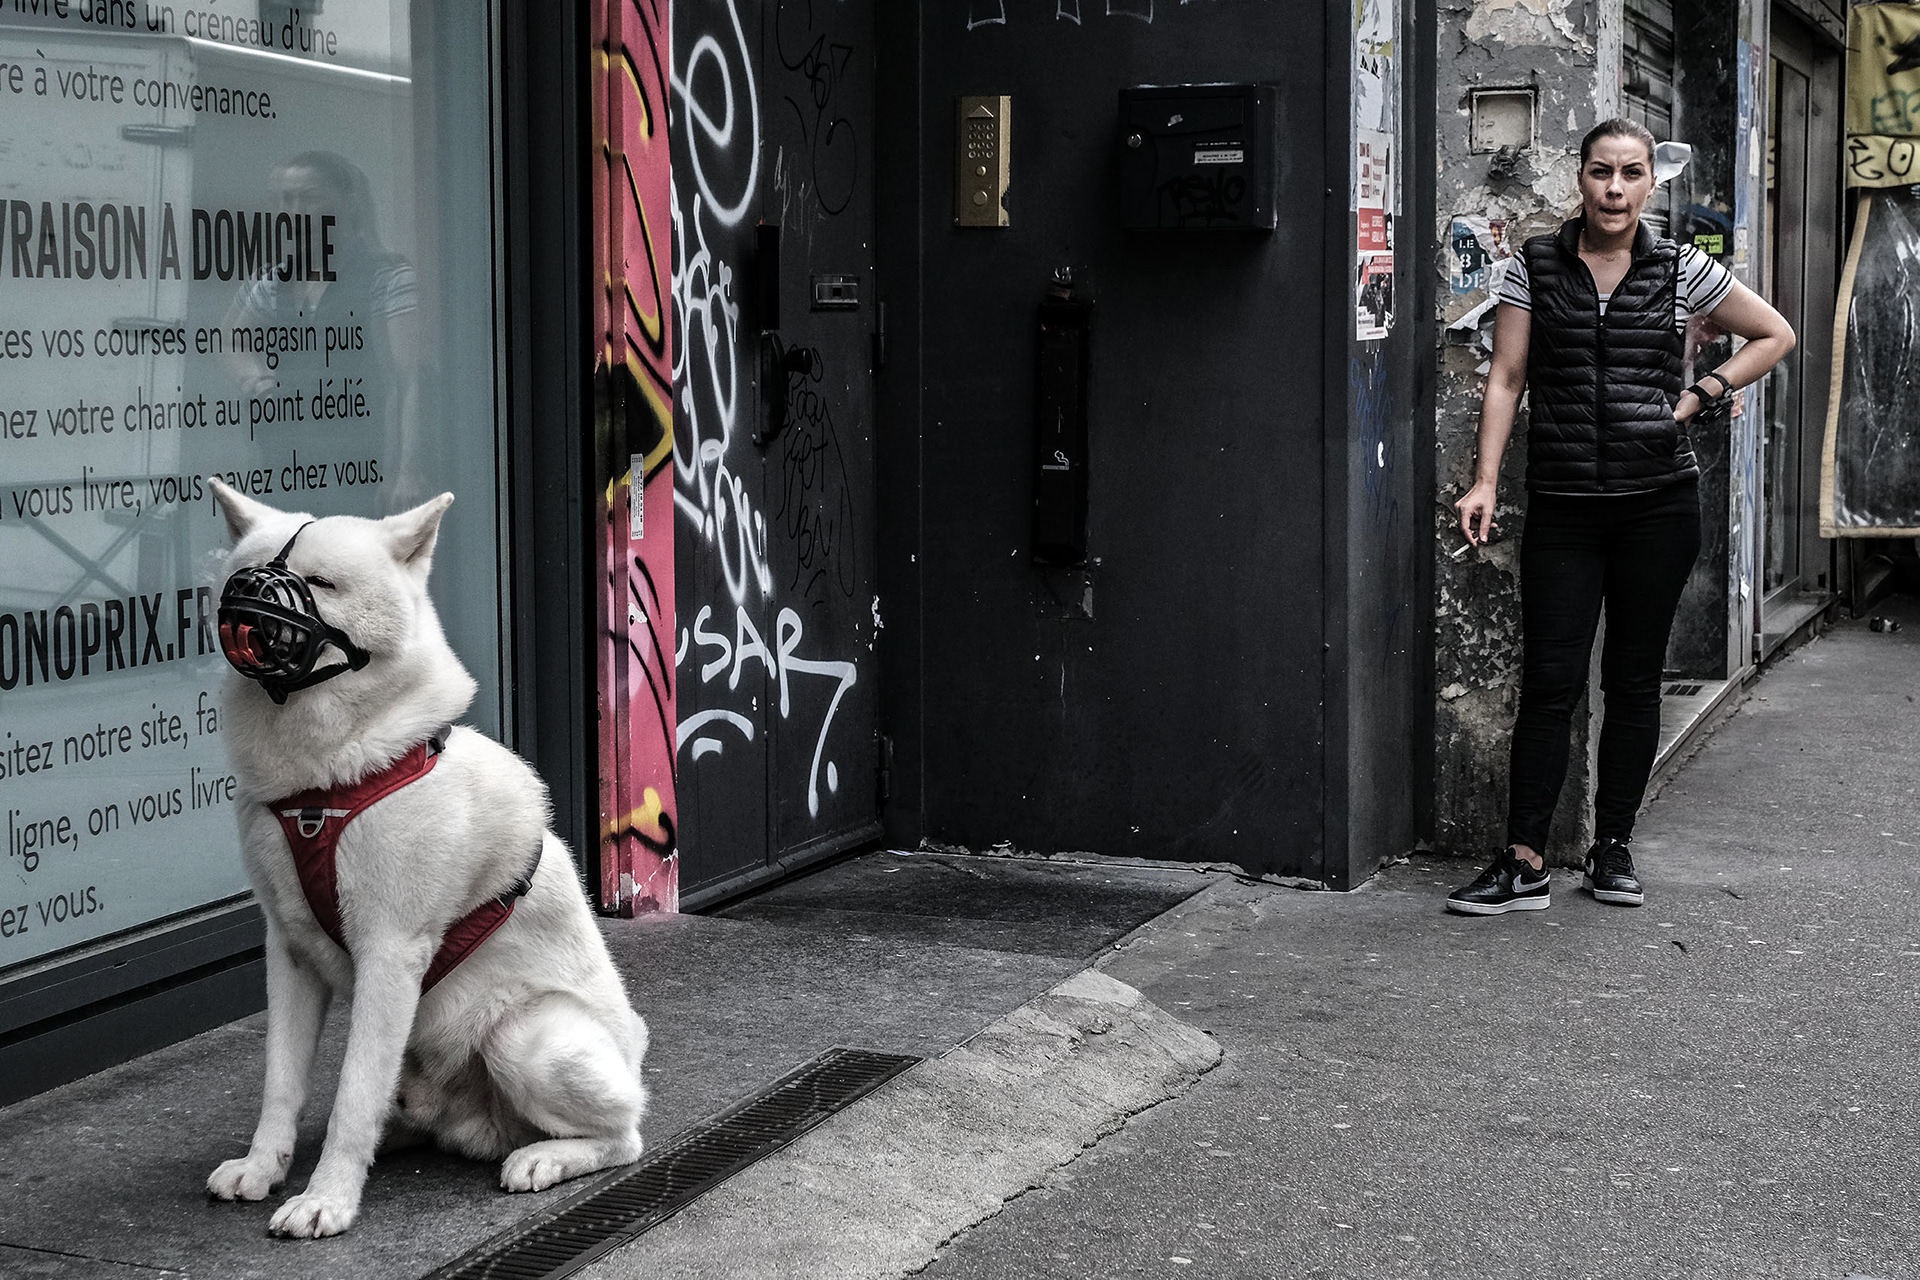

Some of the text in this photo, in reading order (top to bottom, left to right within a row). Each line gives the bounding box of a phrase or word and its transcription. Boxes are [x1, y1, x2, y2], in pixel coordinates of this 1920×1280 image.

[146, 4, 175, 33] un
[282, 8, 337, 55] d'une
[34, 48, 47, 96] à
[57, 65, 124, 104] votre
[133, 78, 276, 119] convenance.
[0, 199, 337, 282] RAISON À DOMICILE
[42, 329, 85, 358] vos
[94, 326, 187, 357] courses
[195, 325, 223, 354] en
[232, 311, 317, 369] magasin
[325, 311, 364, 367] puis
[47, 399, 114, 436] votre
[124, 386, 207, 433] chariot
[216, 400, 241, 426] au
[250, 382, 304, 441] point
[311, 378, 371, 420] dédié.
[12, 486, 73, 518] vous
[83, 466, 141, 517] livre,
[150, 474, 203, 503] vous
[281, 449, 327, 492] chez
[334, 458, 384, 486] vous.
[0, 587, 216, 690] ONOPRIX.FR
[64, 723, 132, 765] notre
[141, 703, 188, 750] site,
[9, 766, 237, 872] ligne, on vous livre
[38, 886, 104, 927] vous.
